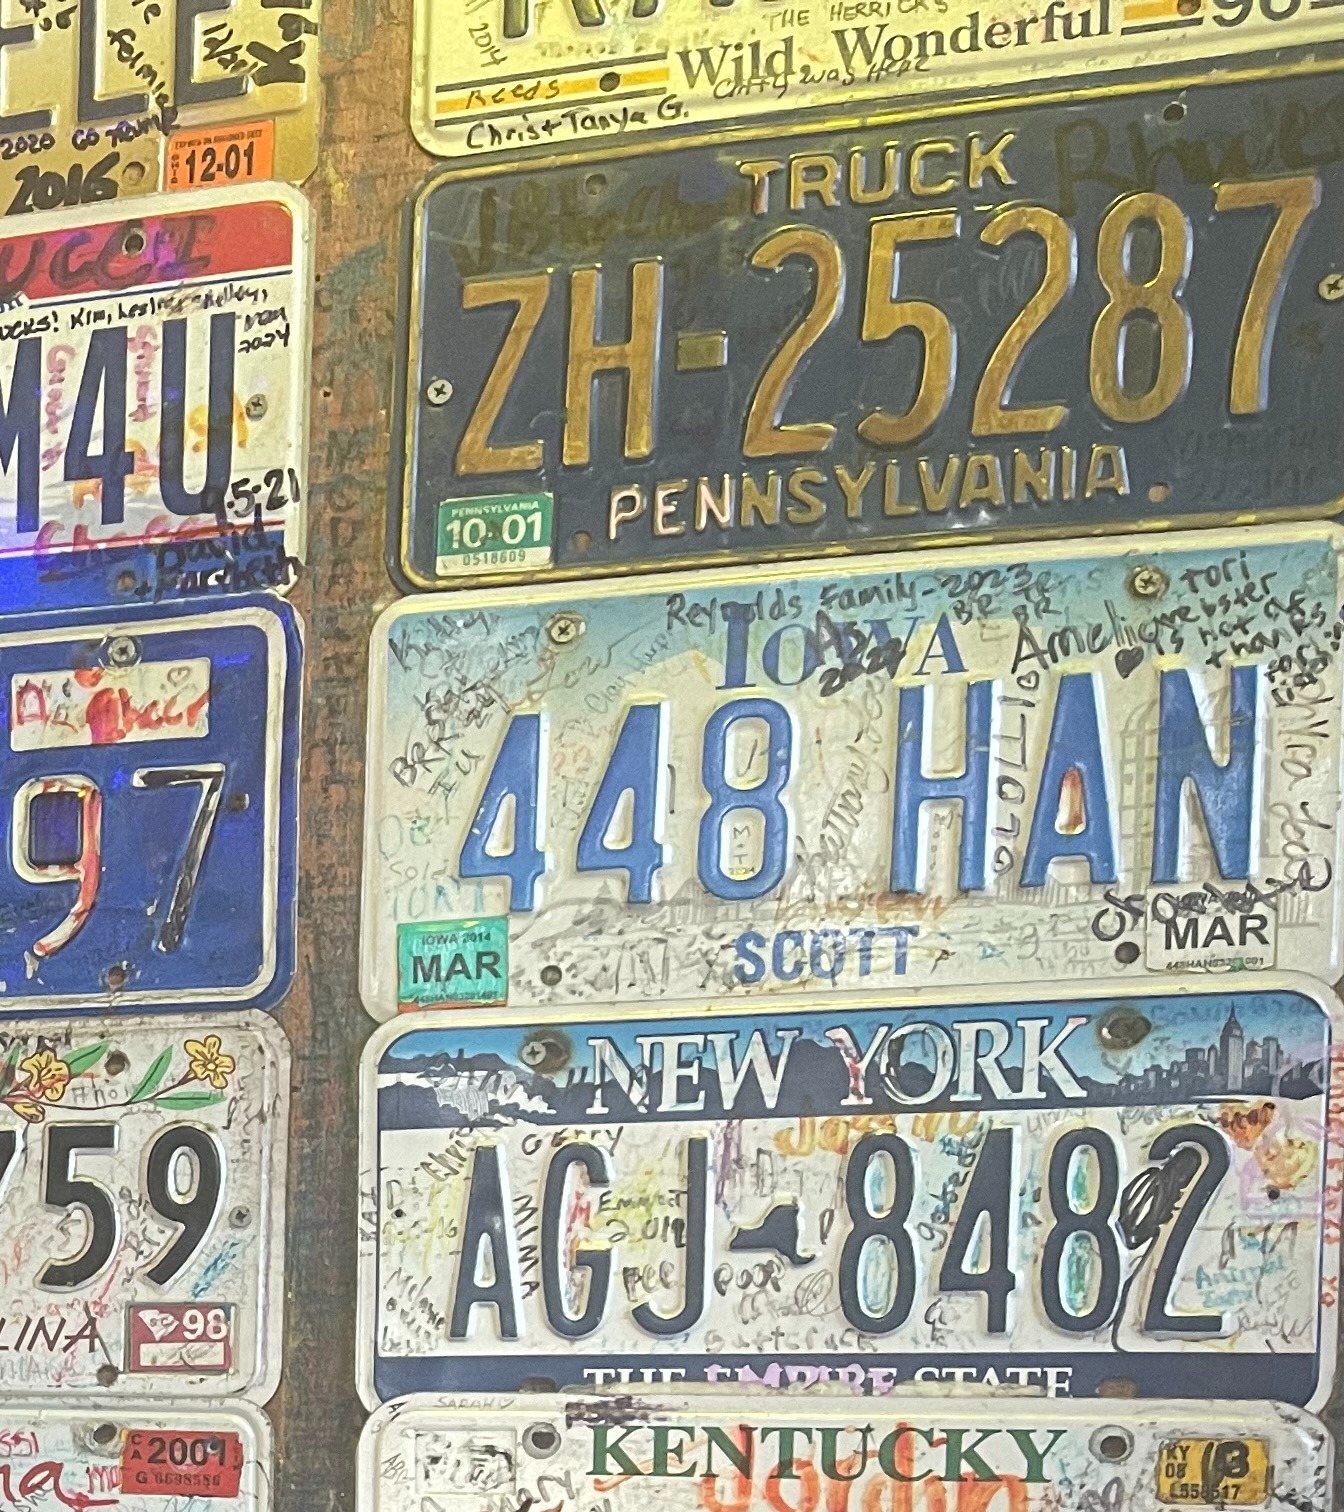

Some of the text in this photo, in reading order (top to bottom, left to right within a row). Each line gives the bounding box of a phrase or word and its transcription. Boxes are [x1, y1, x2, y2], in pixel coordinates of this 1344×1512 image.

[677, 34, 813, 92] Wild,
[831, 0, 1111, 70] Wonderful
[185, 140, 256, 185] 12-01
[736, 129, 1021, 217] TRUCK
[454, 176, 1323, 478] ZH-25287
[608, 442, 1132, 542] PENNSYLVANIA
[444, 512, 543, 551] 10-01
[458, 662, 1261, 914] 448 HAN
[411, 949, 503, 985] MAR
[732, 925, 921, 985] SCOTT
[1162, 911, 1271, 950] MAR
[585, 1015, 1092, 1116] NEW YORK
[449, 1134, 711, 1340] AGJ
[838, 1123, 1234, 1338] 8482
[182, 1308, 228, 1341] 98
[585, 1424, 1069, 1482] KENTUCKY
